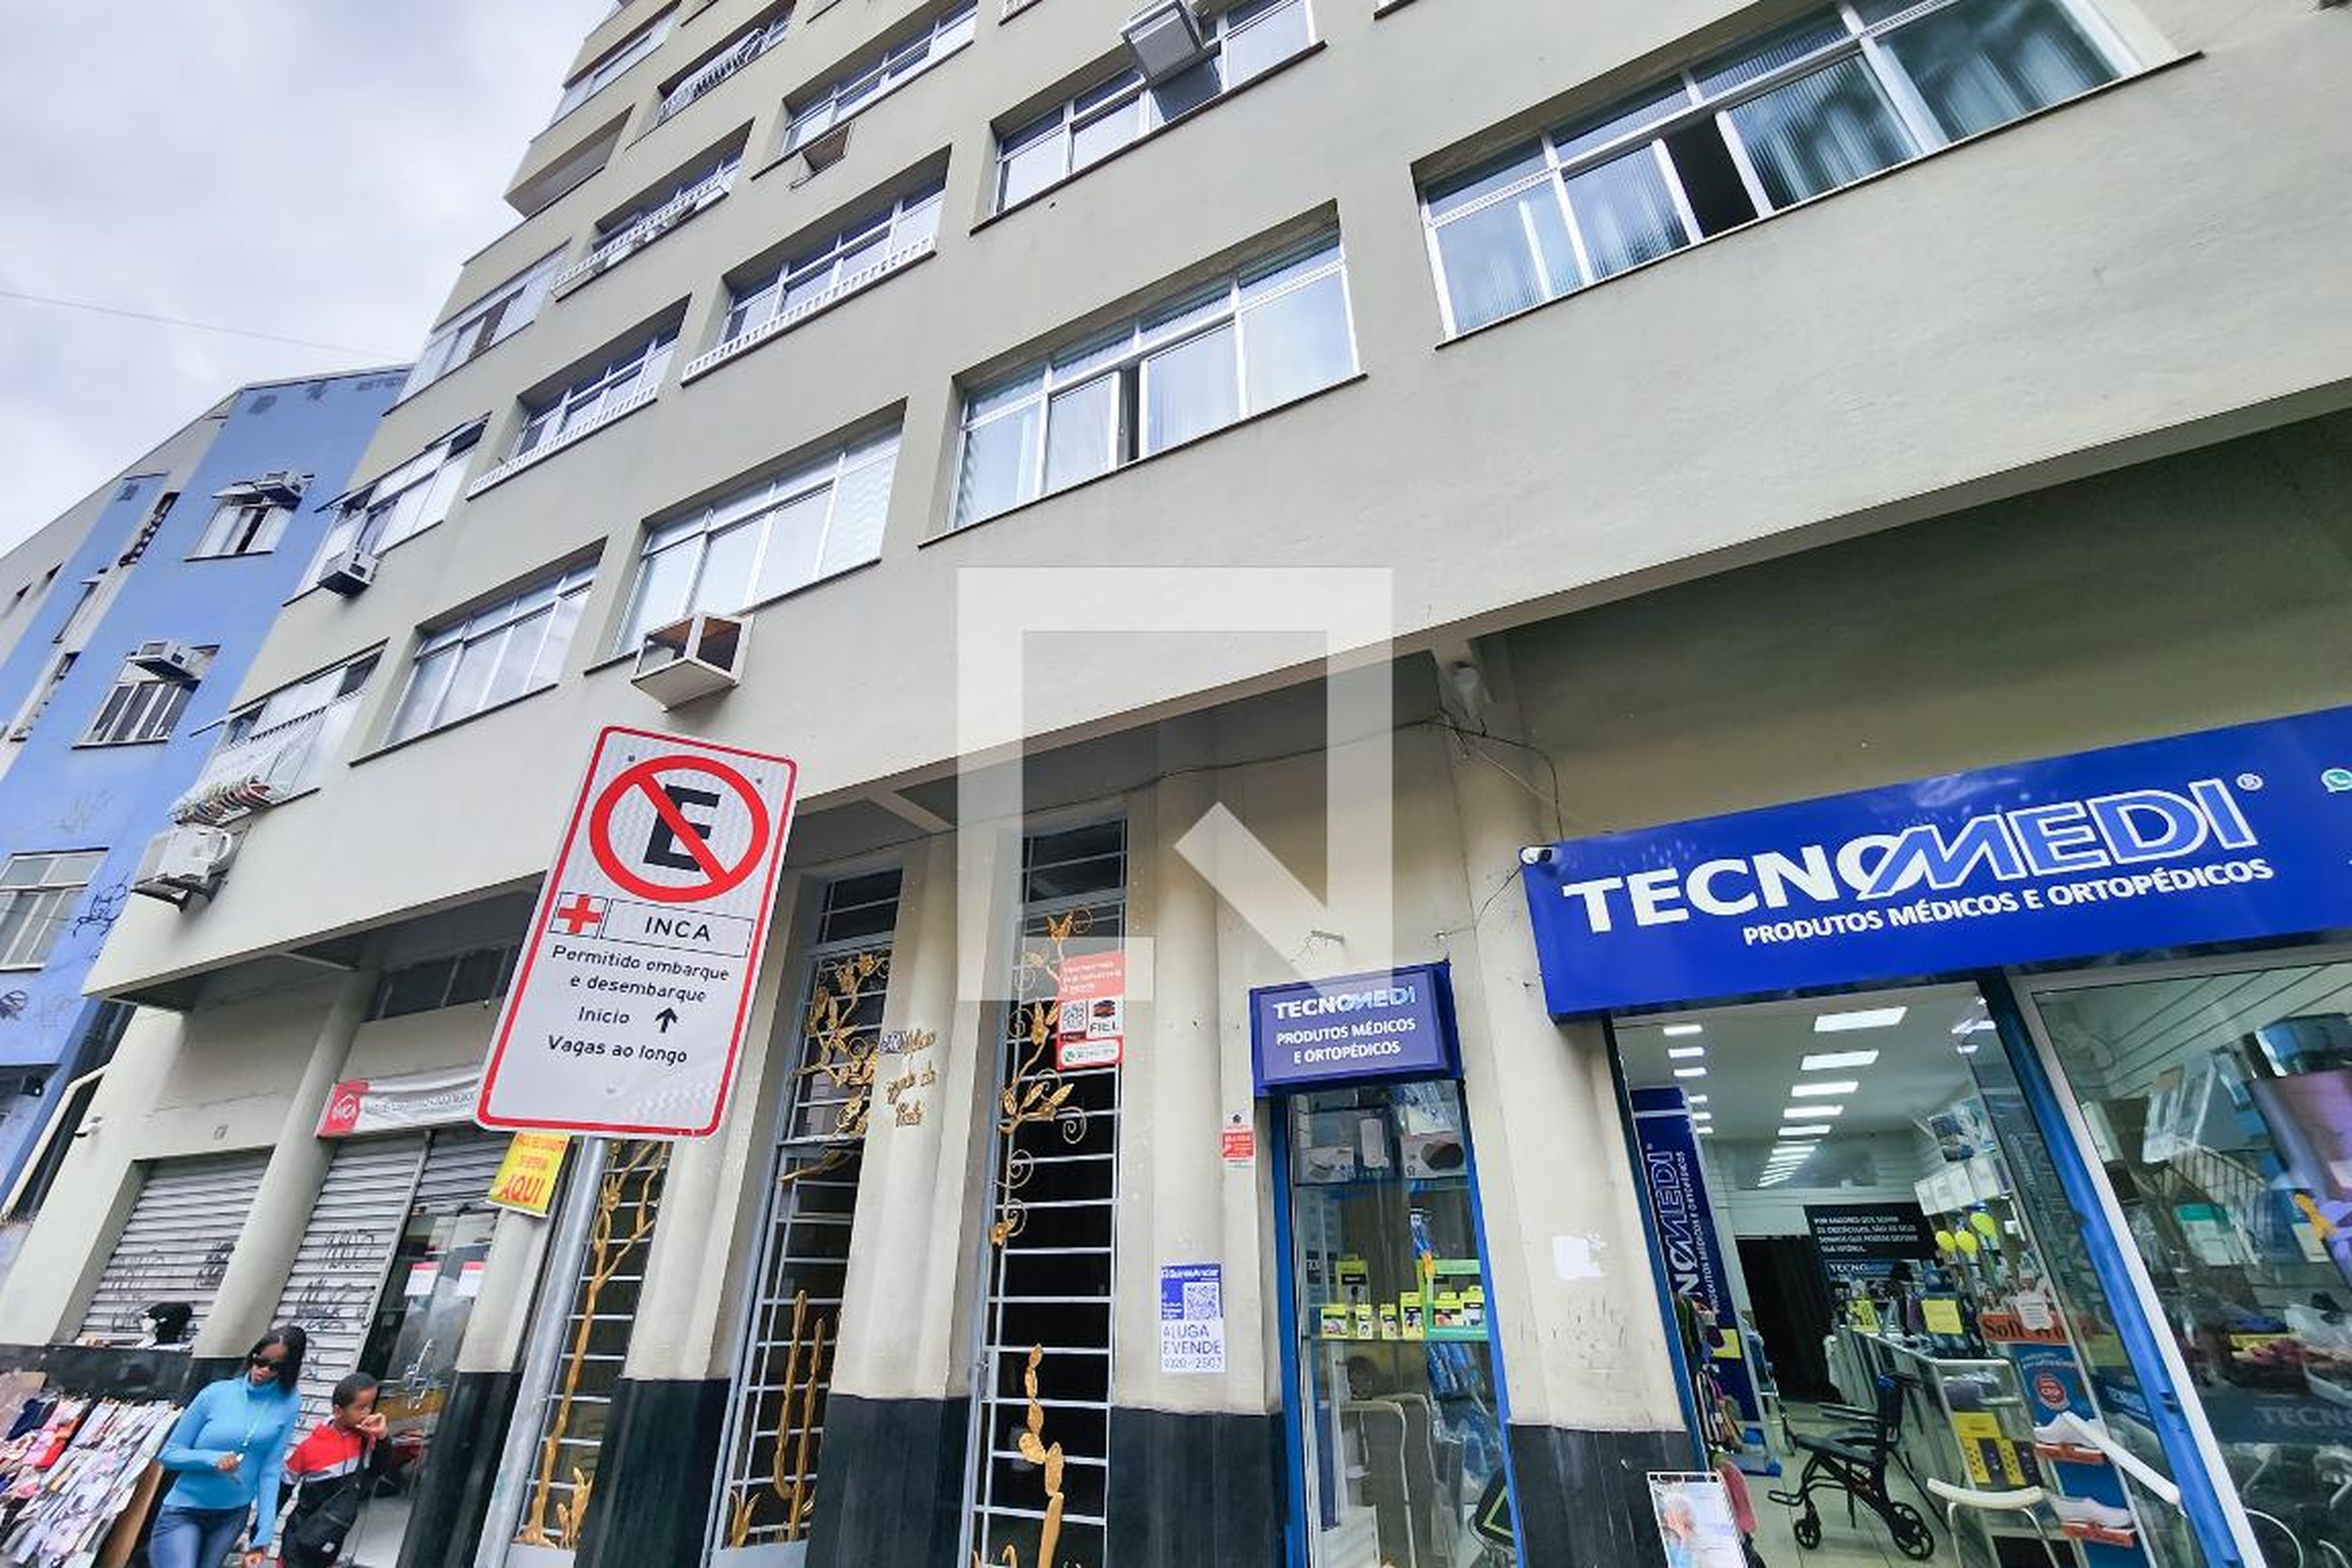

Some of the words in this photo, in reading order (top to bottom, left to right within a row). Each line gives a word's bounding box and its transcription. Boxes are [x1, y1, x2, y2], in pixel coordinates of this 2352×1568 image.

[643, 783, 722, 872] E
[1562, 778, 2258, 933] TECNOMEDI
[1743, 910, 1884, 946] PRODUTOS
[1888, 891, 2021, 929] MÉDICOS
[2024, 889, 2044, 910] E
[2049, 859, 2274, 907] ORTOPÉDICOS
[644, 916, 711, 942] INCA
[552, 944, 641, 969] Permitido
[646, 960, 729, 982] embarque
[570, 975, 580, 987] e
[587, 975, 706, 1003] desembarque
[1273, 986, 1416, 1020] TECNOMEDI
[1276, 1025, 1348, 1046] PRODUTOS
[1351, 1017, 1416, 1038] MÉDICOS
[548, 1035, 606, 1057] Vagas
[612, 1045, 634, 1058] ao
[639, 1045, 687, 1066] longo
[1294, 1050, 1302, 1064] E
[1304, 1040, 1402, 1063] ORTOPÉDICOS
[1163, 1324, 1210, 1338] ALUGA
